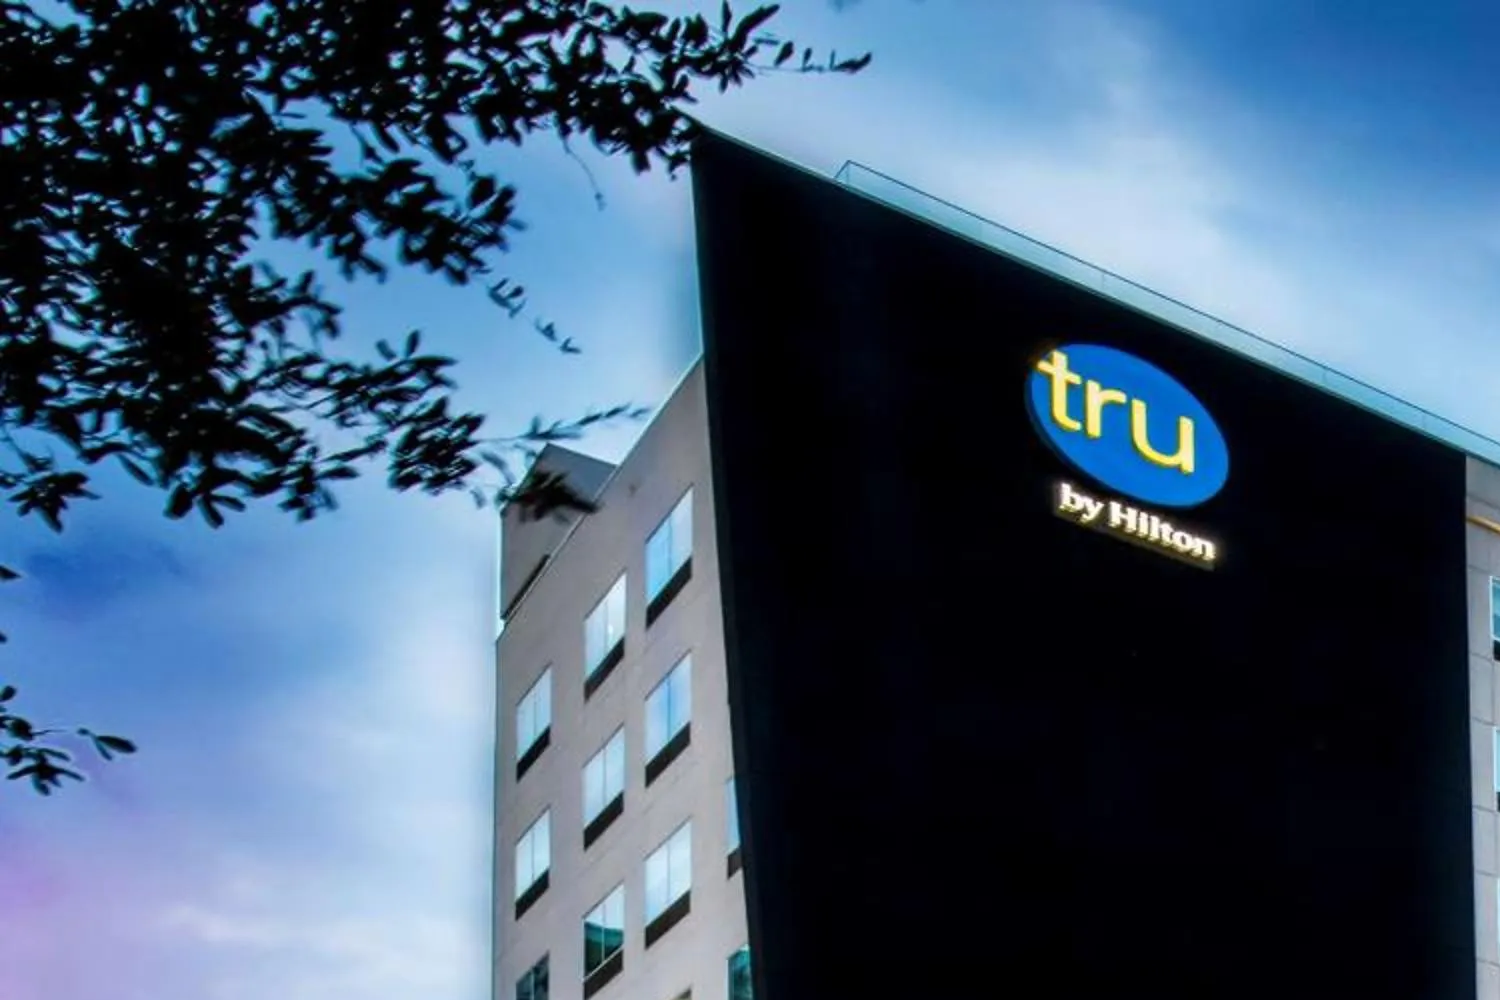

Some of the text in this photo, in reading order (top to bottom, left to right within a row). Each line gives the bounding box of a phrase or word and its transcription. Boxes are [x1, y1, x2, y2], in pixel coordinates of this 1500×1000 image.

[1037, 350, 1195, 475] tru
[1059, 483, 1217, 561] by Hilton
